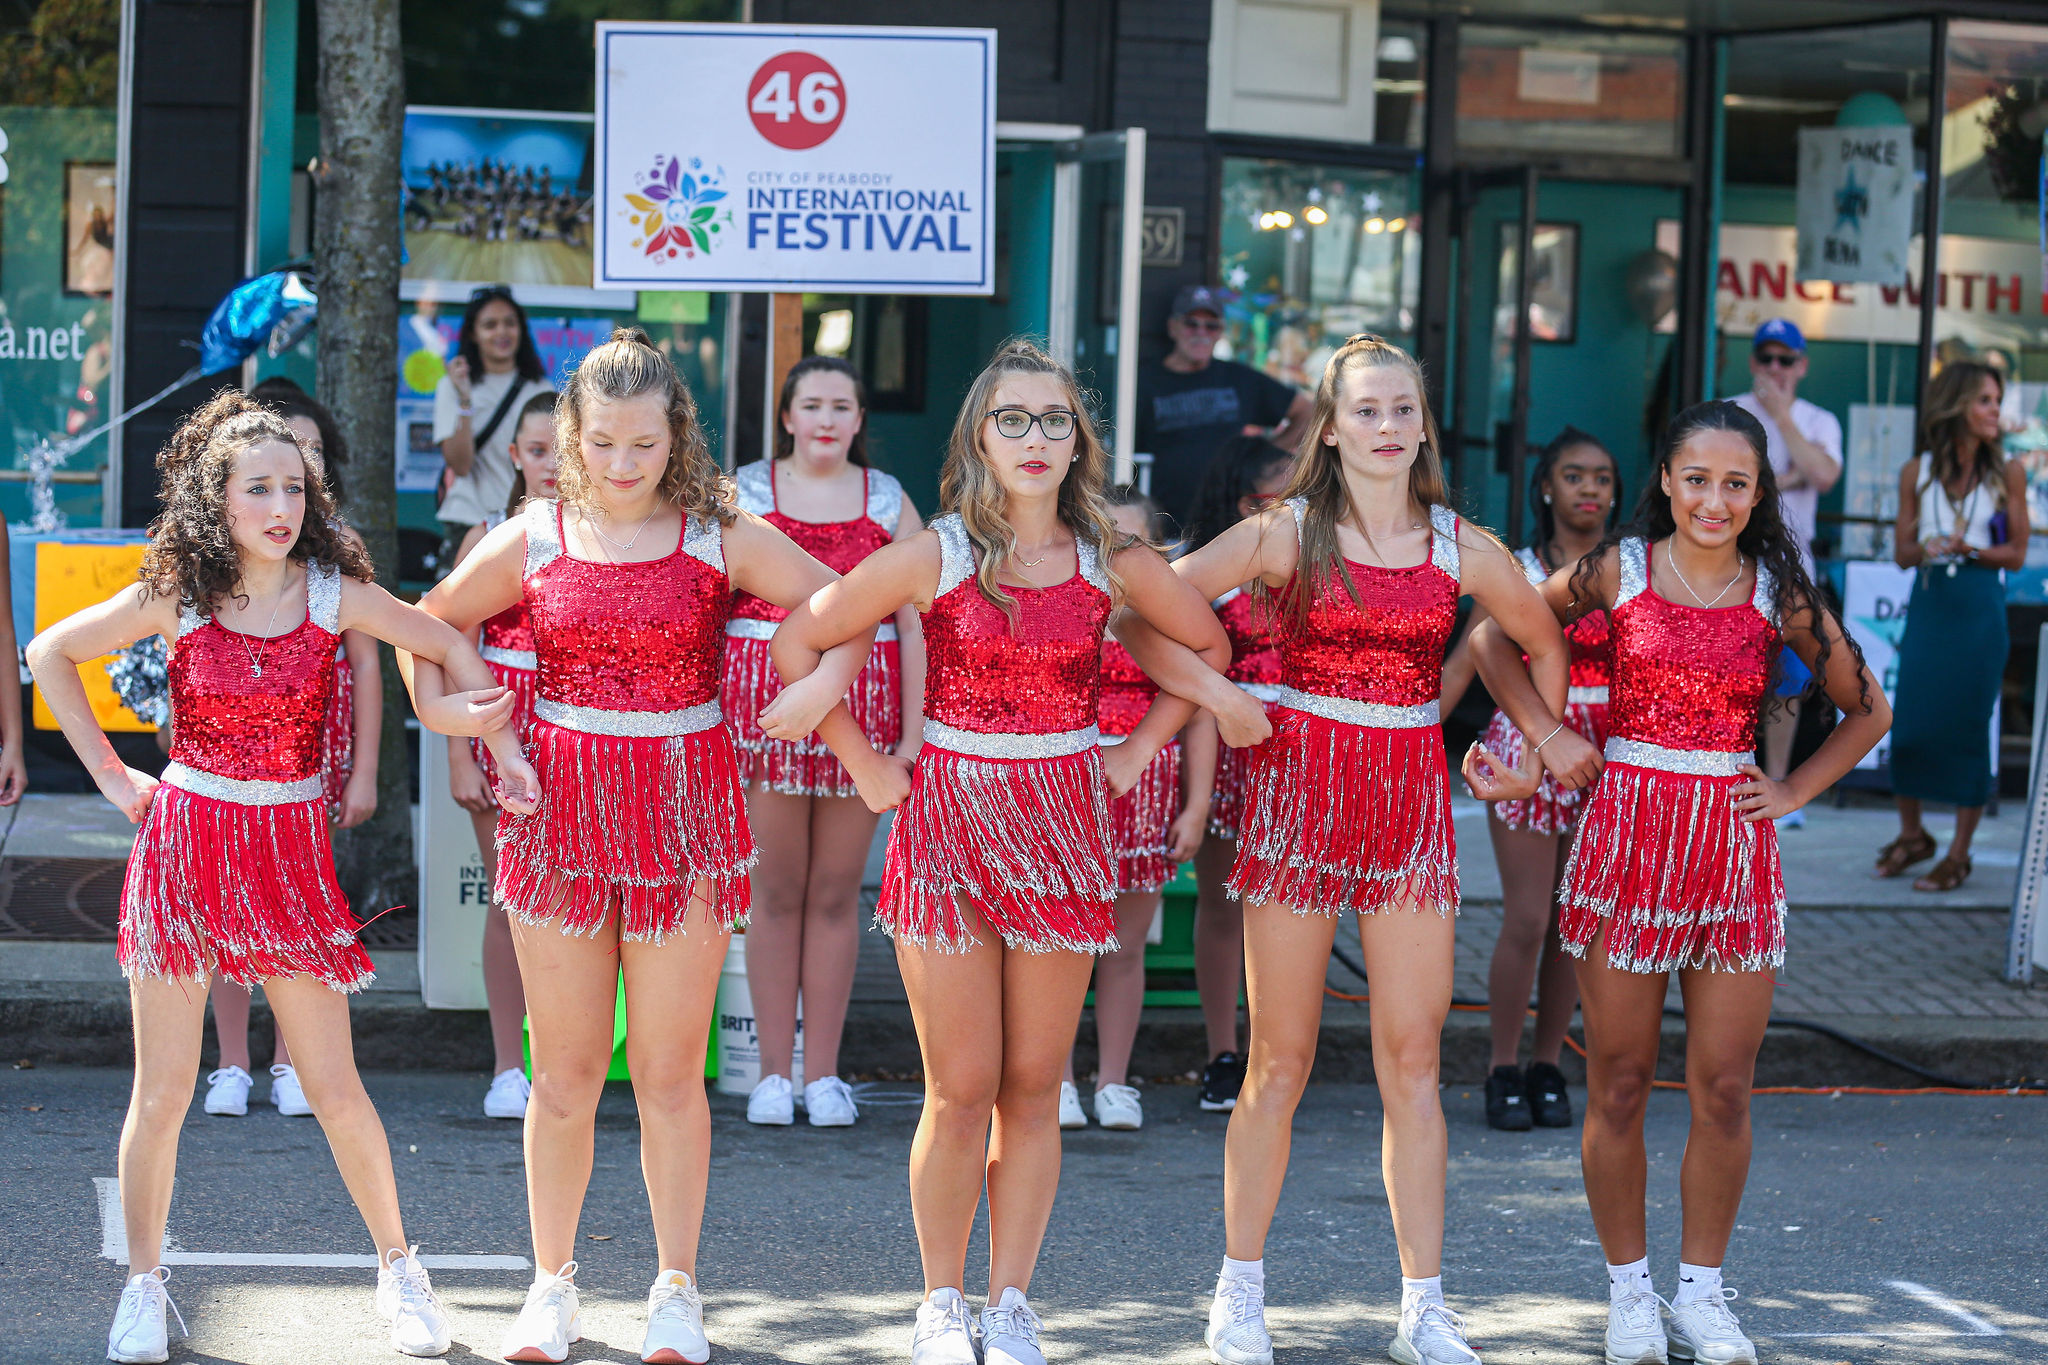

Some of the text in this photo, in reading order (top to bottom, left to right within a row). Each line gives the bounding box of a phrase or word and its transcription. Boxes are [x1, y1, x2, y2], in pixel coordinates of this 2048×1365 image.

[751, 70, 841, 124] 46
[1840, 138, 1898, 167] DANCE
[747, 171, 893, 185] CITY OF PEABODY
[747, 188, 972, 212] INTERNATIONAL
[747, 212, 972, 251] FESTIVAL
